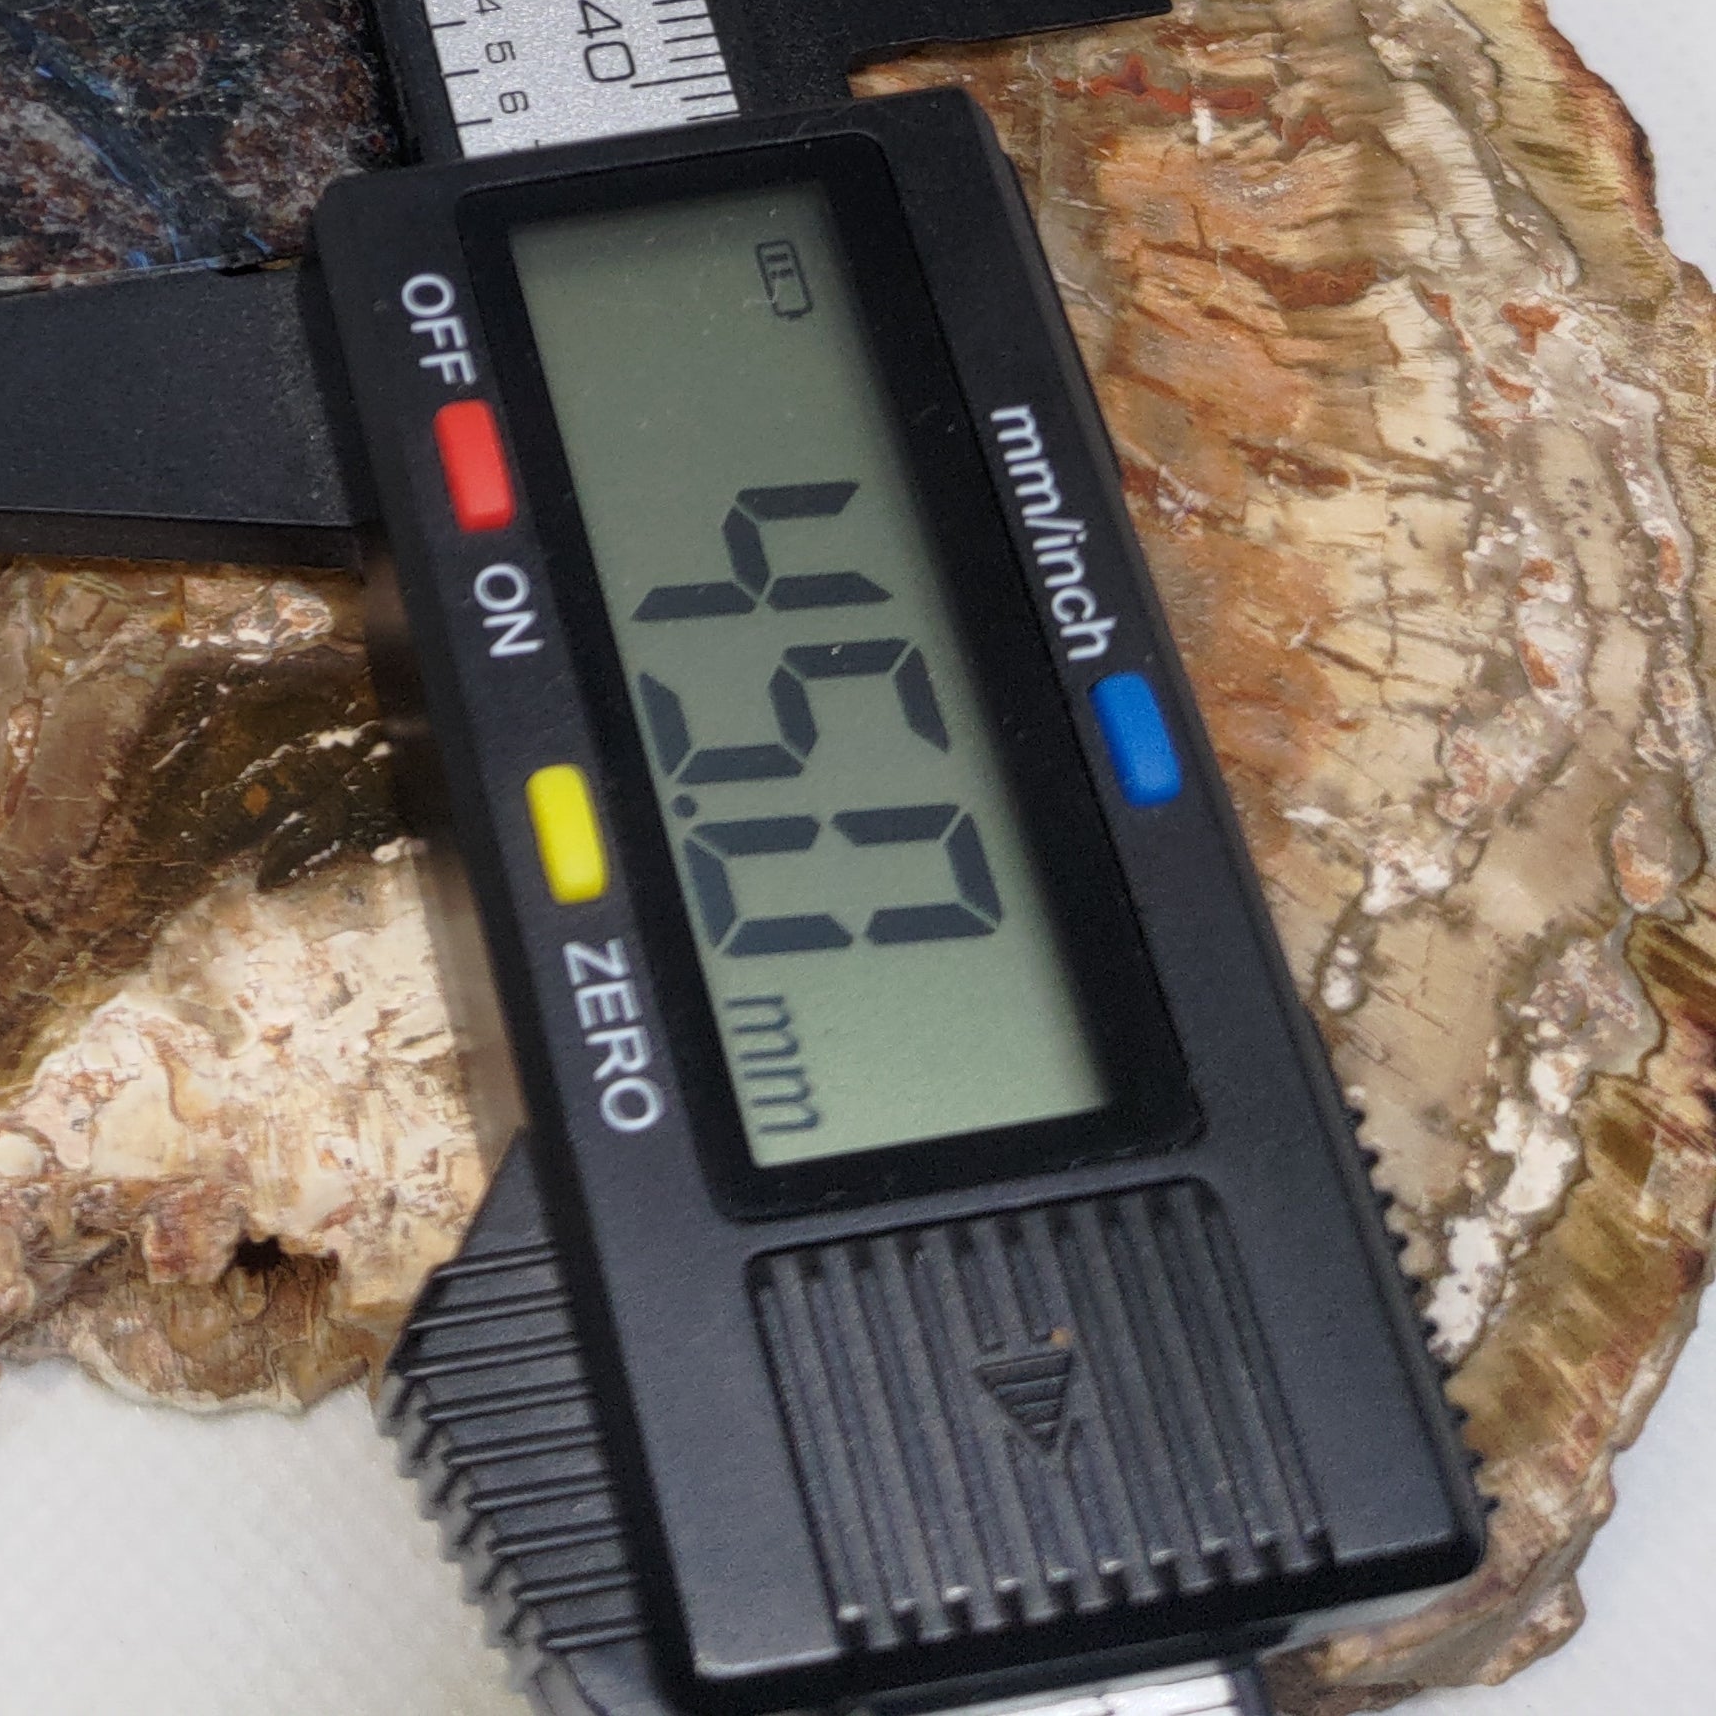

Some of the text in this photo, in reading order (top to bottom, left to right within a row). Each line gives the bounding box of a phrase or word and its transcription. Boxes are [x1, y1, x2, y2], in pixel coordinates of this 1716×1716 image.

[485, 41, 516, 65] 5
[576, 0, 636, 83] 40
[499, 90, 530, 115] 6
[400, 273, 477, 386] OFF
[990, 404, 1118, 662] mm/inch
[473, 562, 545, 658] ON
[631, 481, 1002, 1137] 45.0 mm
[563, 939, 662, 1134] ZERO
